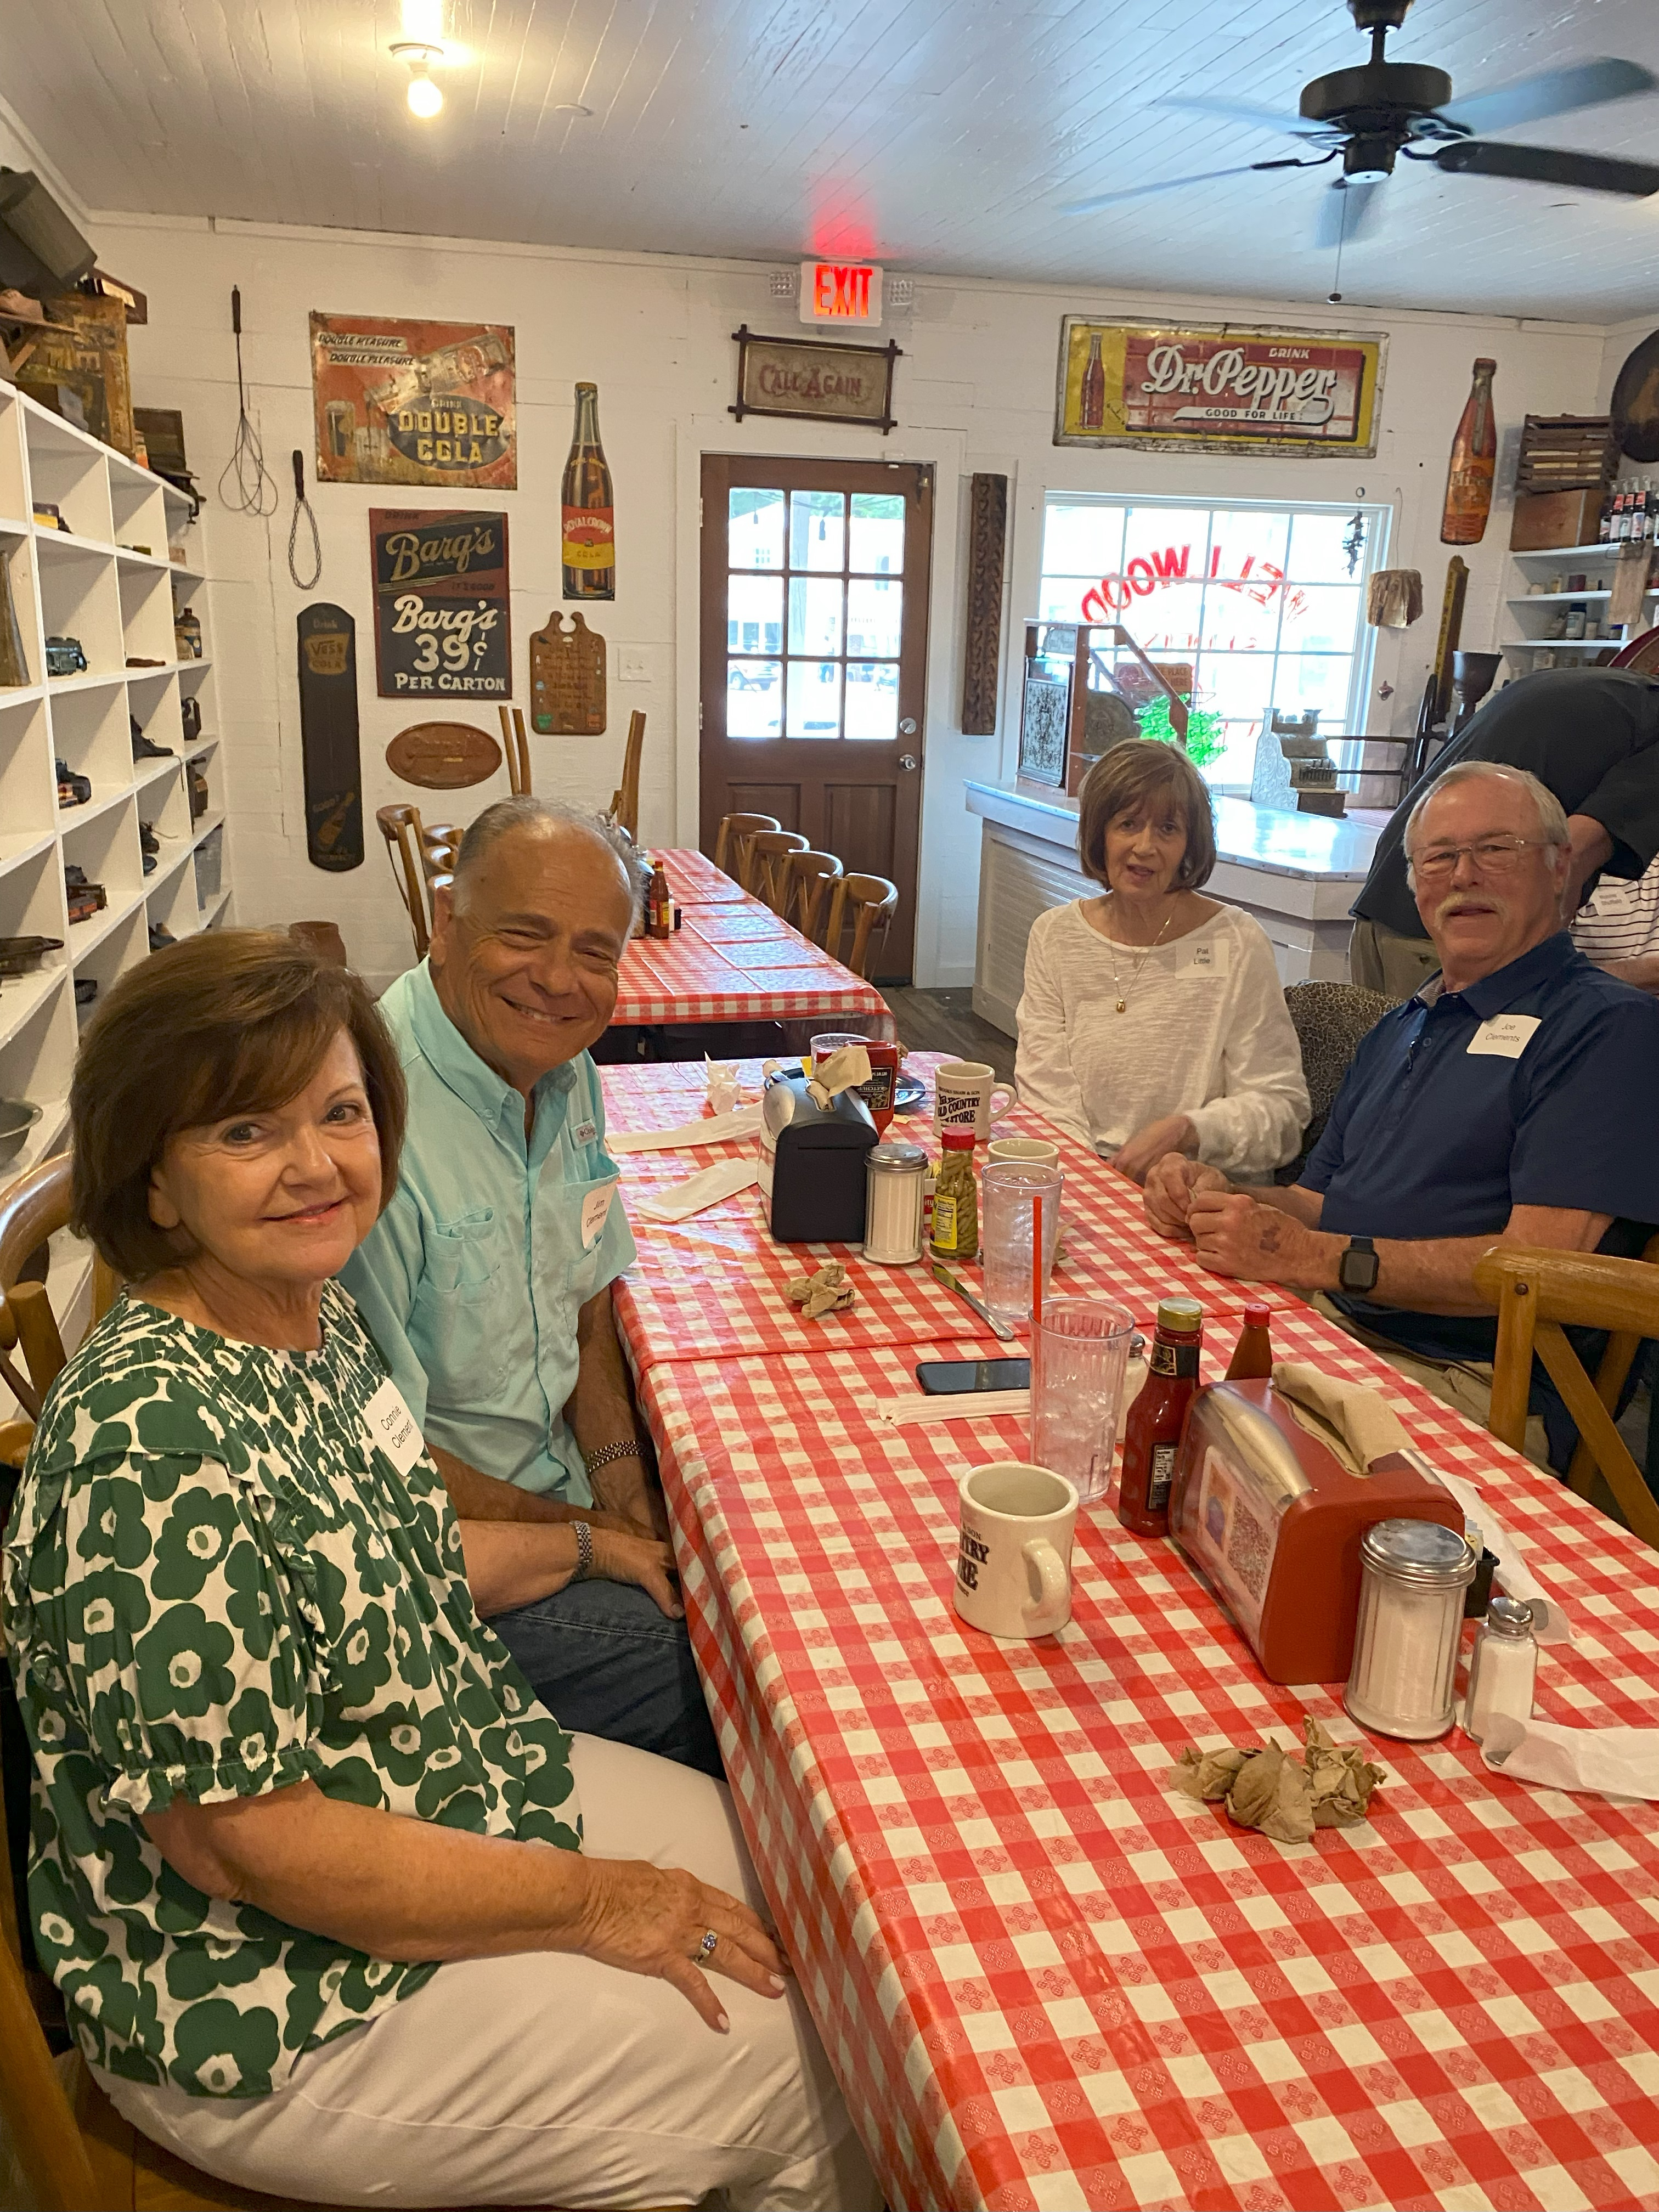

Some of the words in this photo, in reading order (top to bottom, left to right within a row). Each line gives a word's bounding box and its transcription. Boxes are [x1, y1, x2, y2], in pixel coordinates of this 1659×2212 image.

[814, 264, 873, 318] EXIT
[319, 334, 355, 345] DOUBLE
[1268, 347, 1310, 359] DRINK
[759, 364, 799, 396] CALL
[802, 367, 862, 399] AGAIN
[1141, 344, 1199, 394] Dr.
[1202, 347, 1338, 411] Pepper
[398, 410, 499, 436] DOUBLE
[1205, 408, 1237, 417] GOOD
[1244, 410, 1266, 420] FOR
[417, 438, 483, 464] COLA
[563, 516, 585, 533] ROYAL
[385, 526, 495, 582] Barq's
[392, 594, 498, 642] Barq's
[394, 673, 435, 690] PER
[438, 673, 506, 691] CARTON
[949, 1097, 980, 1114] COUNTRY
[950, 1109, 976, 1124] STORE
[381, 1404, 402, 1431] Connie
